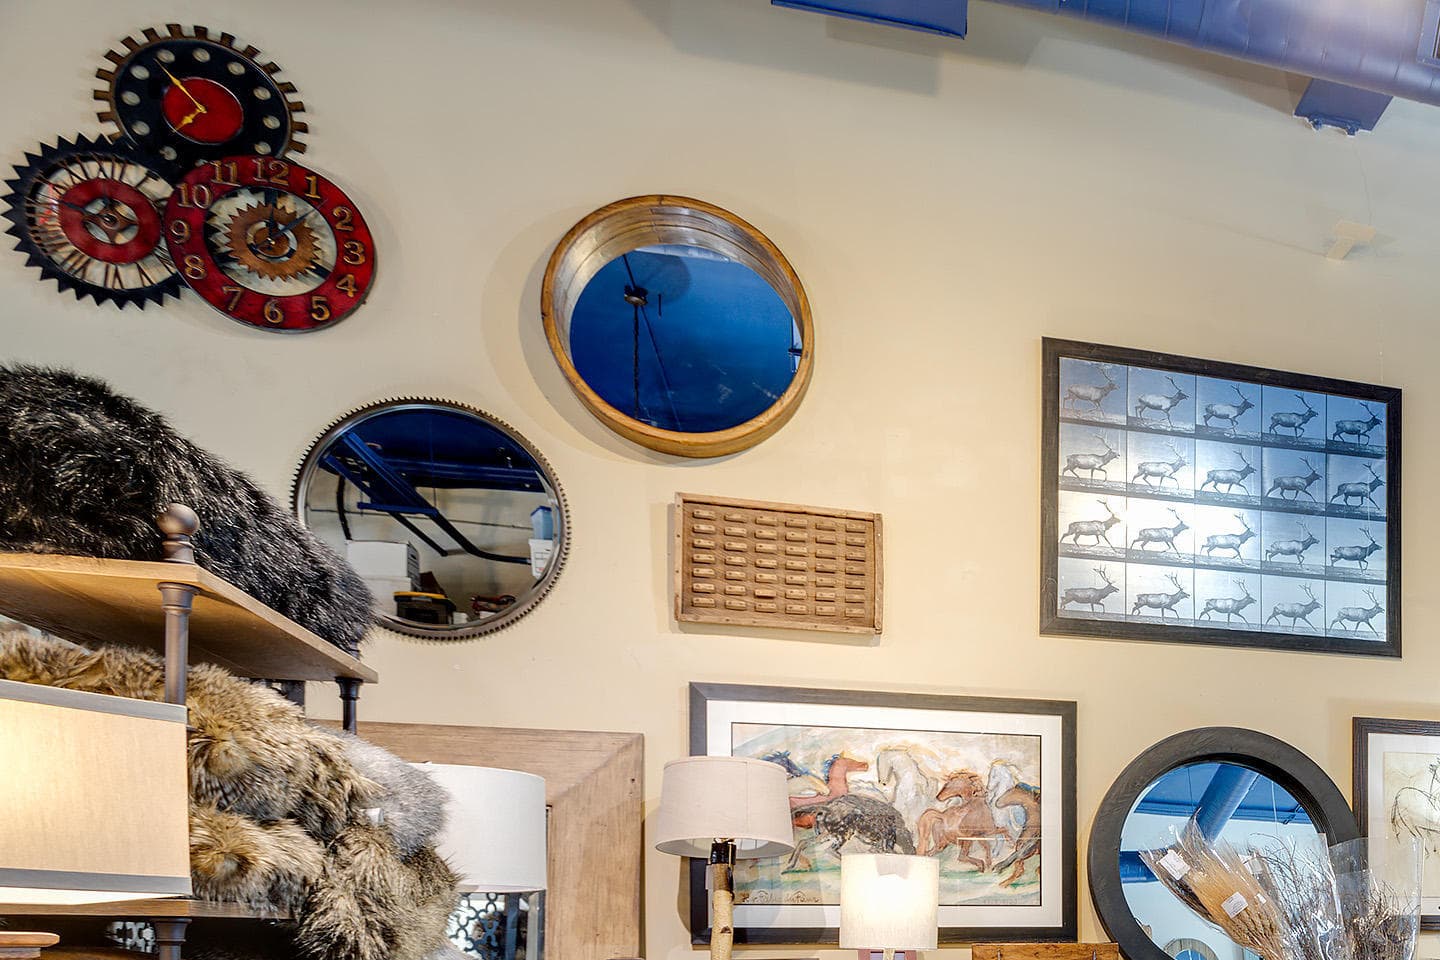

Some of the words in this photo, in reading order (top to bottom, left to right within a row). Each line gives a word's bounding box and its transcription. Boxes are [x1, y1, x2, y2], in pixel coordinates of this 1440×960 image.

[211, 160, 241, 187] 11
[252, 158, 289, 186] 12
[177, 183, 212, 209] 10
[305, 175, 321, 199] 1
[170, 219, 191, 245] 9
[332, 206, 354, 232] 2
[344, 240, 365, 265] 3
[184, 254, 207, 280] 8
[222, 285, 243, 311] 7
[336, 274, 358, 298] 4
[264, 299, 284, 324] 6
[311, 296, 330, 321] 5
